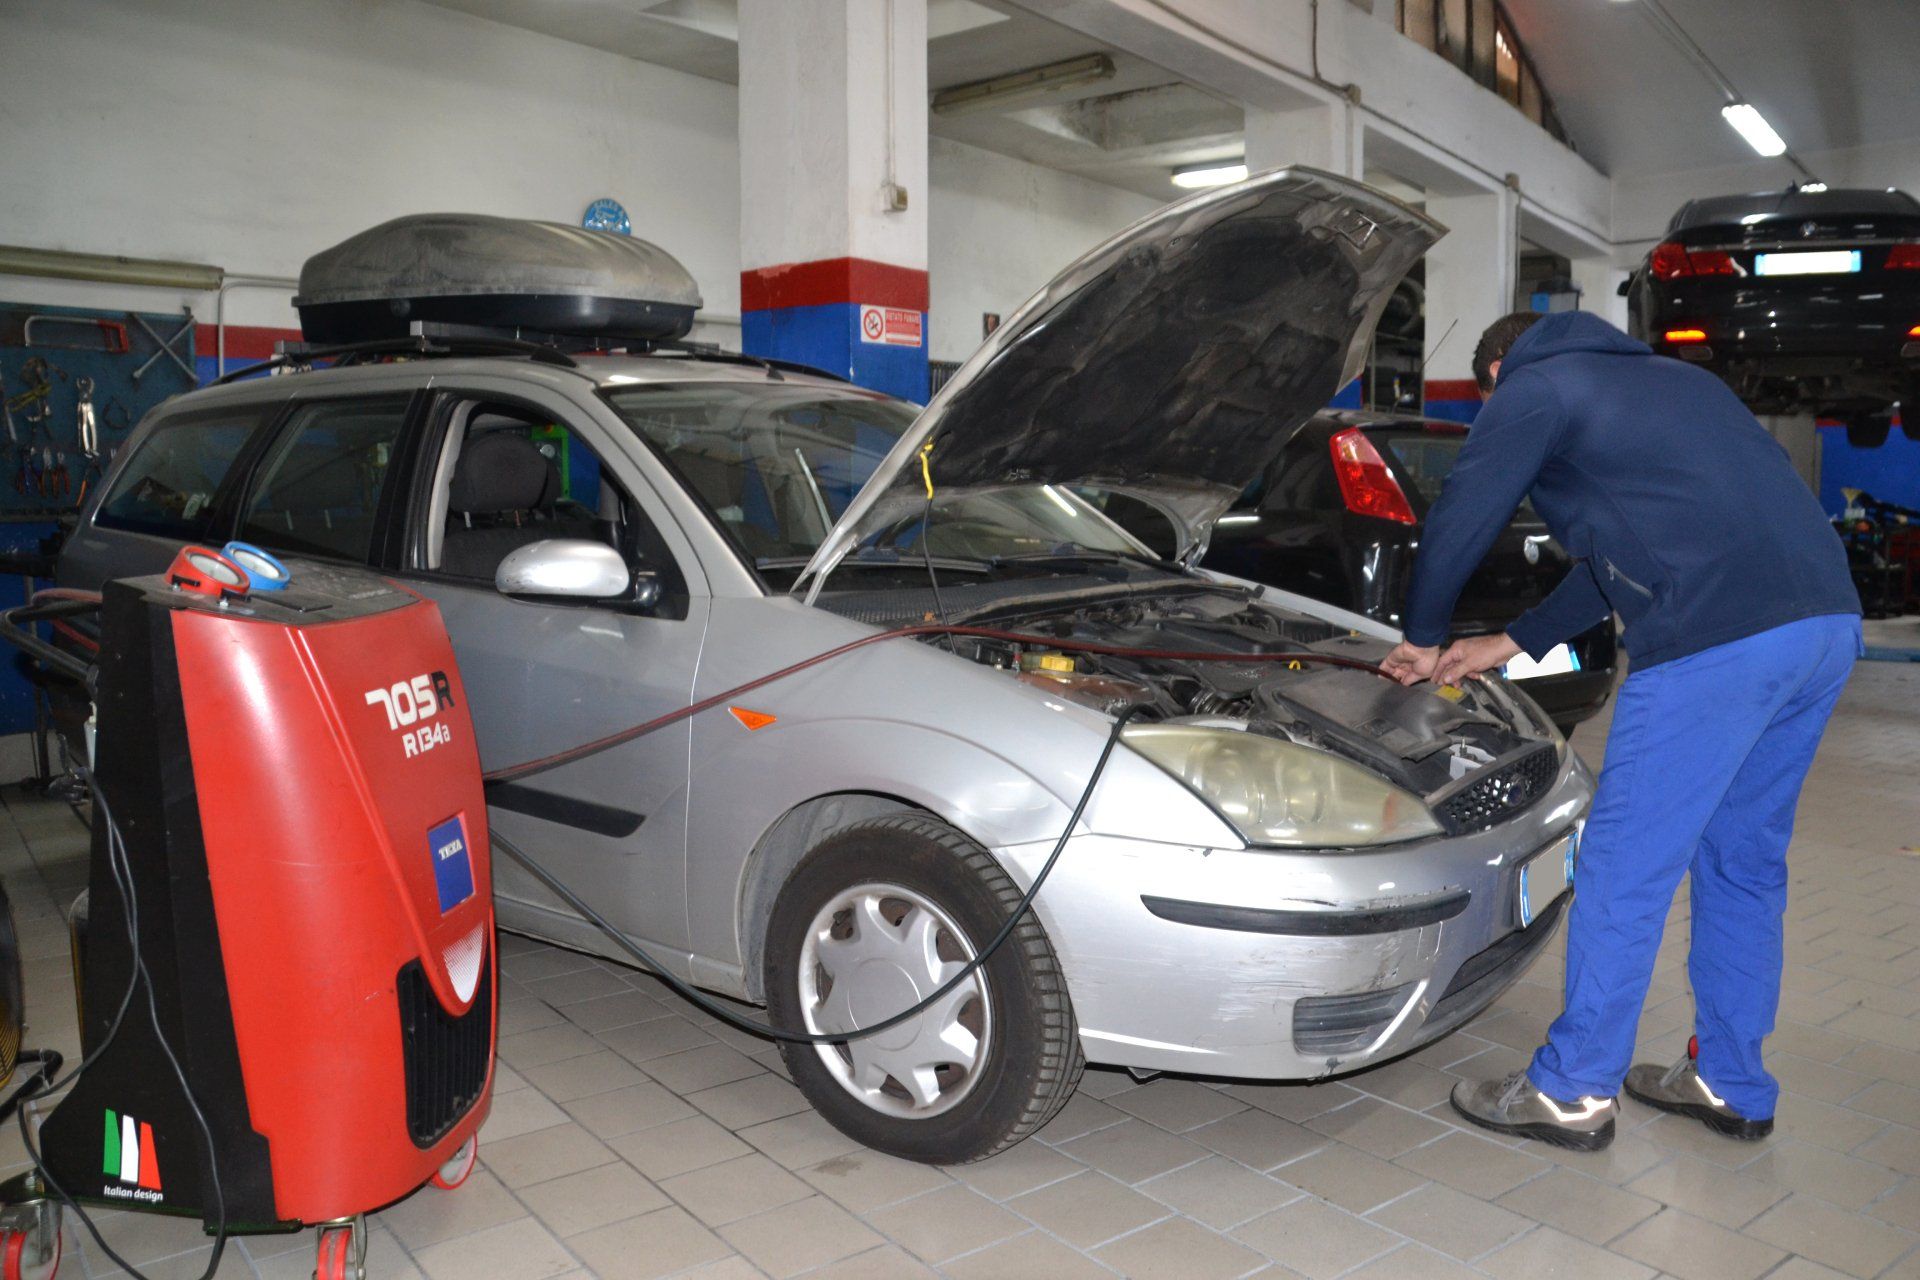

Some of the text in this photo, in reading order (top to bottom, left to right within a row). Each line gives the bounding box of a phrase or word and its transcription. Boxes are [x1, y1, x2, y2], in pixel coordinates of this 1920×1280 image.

[365, 671, 455, 731] 705R
[104, 1185, 163, 1203] Italian design
